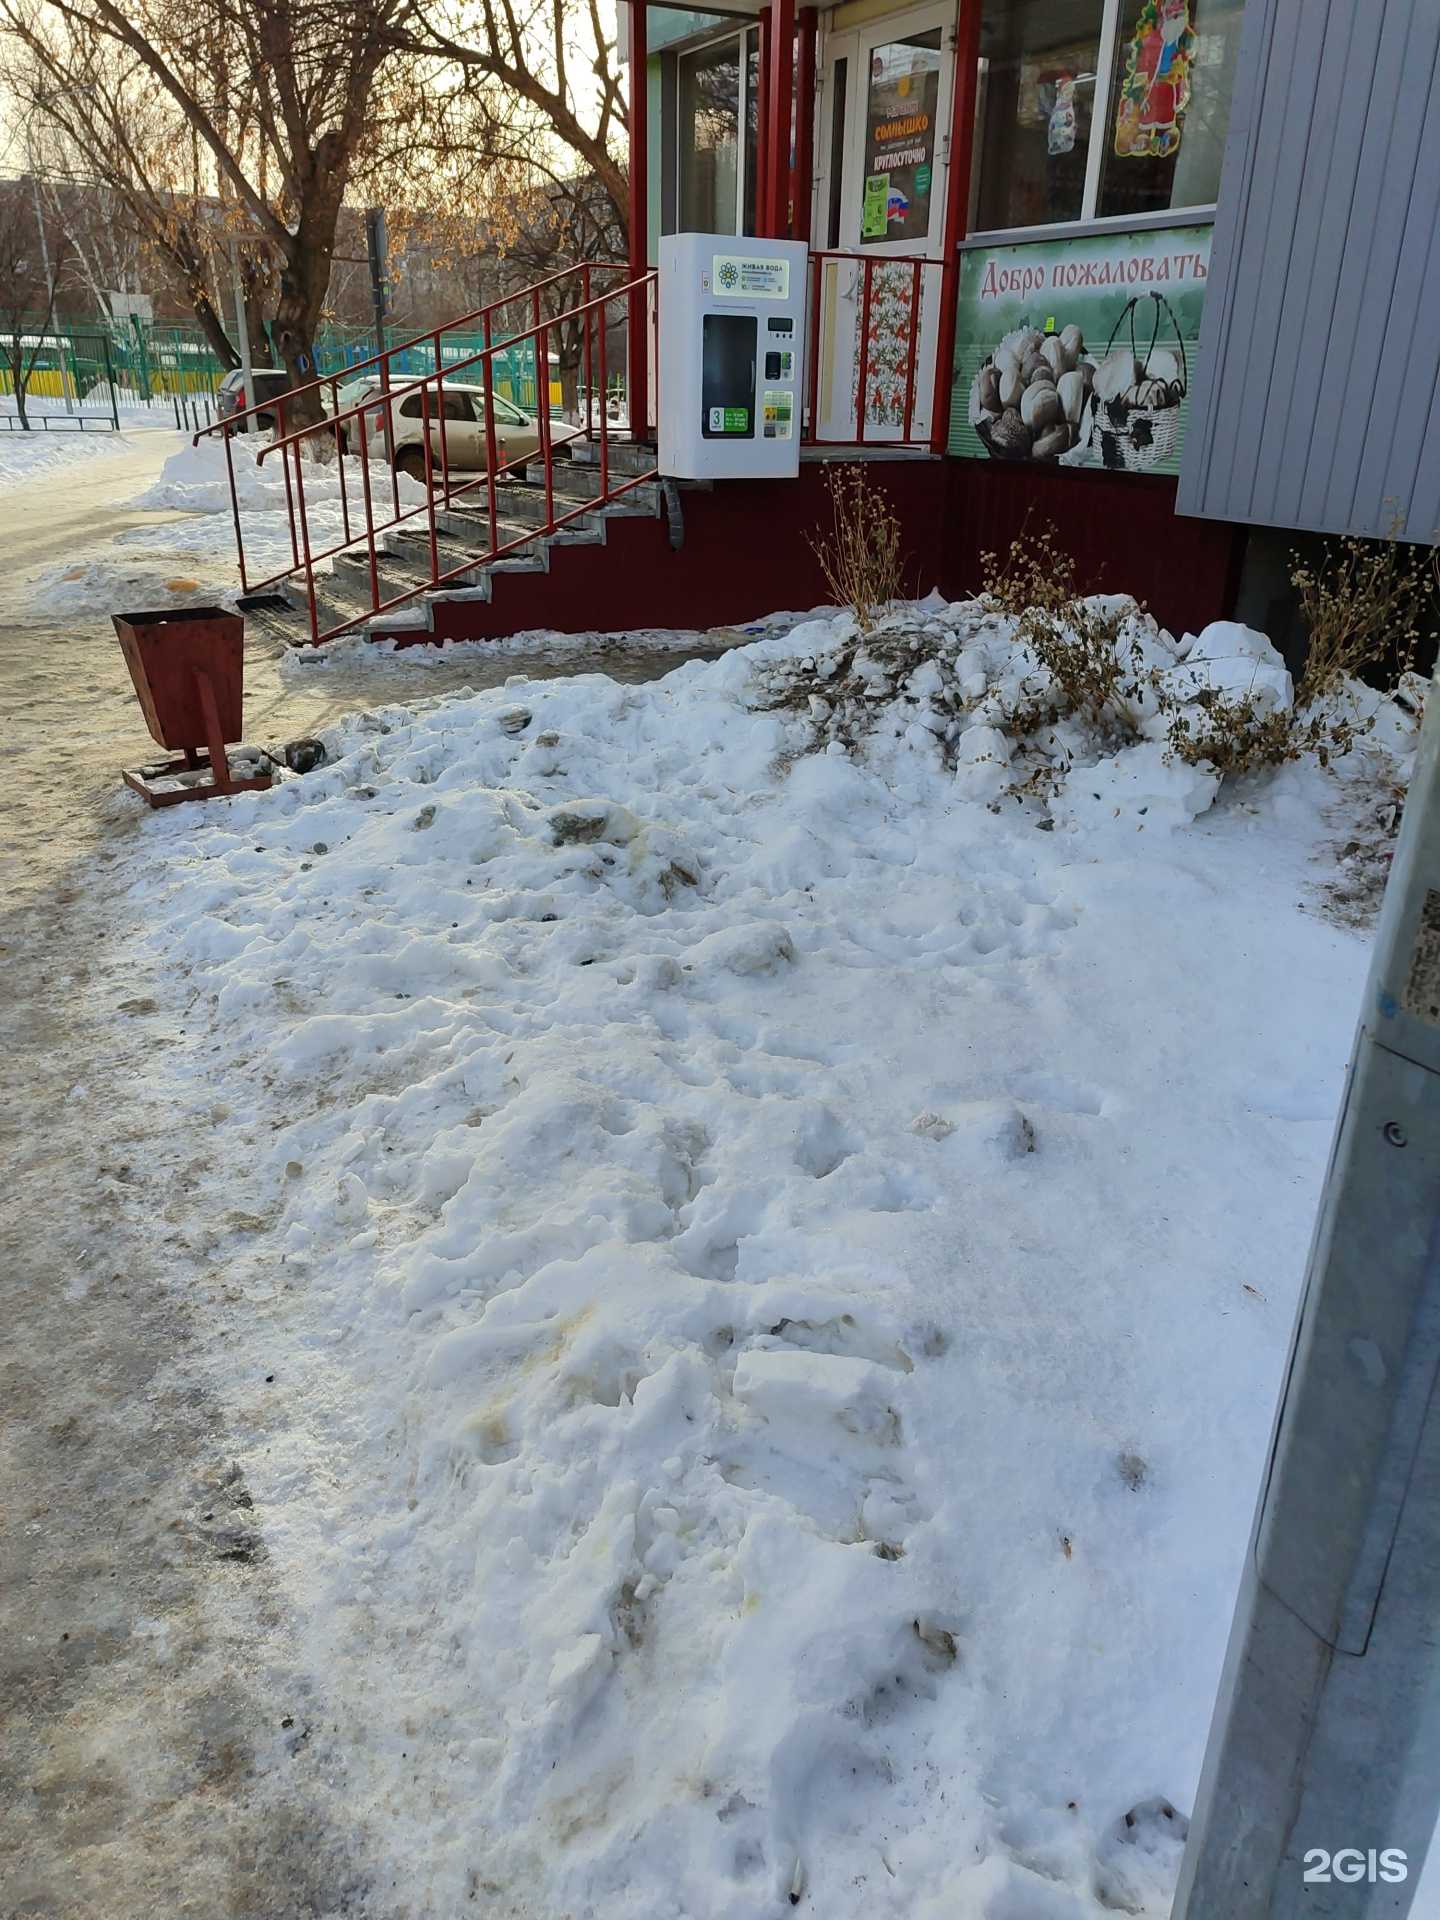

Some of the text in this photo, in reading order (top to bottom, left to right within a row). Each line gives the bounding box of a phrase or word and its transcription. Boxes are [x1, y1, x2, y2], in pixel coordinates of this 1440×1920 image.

[874, 114, 928, 141] СОЛНЫШКО
[873, 146, 926, 171] КРУГЛОСУТОЧНО
[766, 264, 783, 272] ВОДА
[981, 253, 1208, 299] Добро пожаловать
[713, 410, 721, 425] 3
